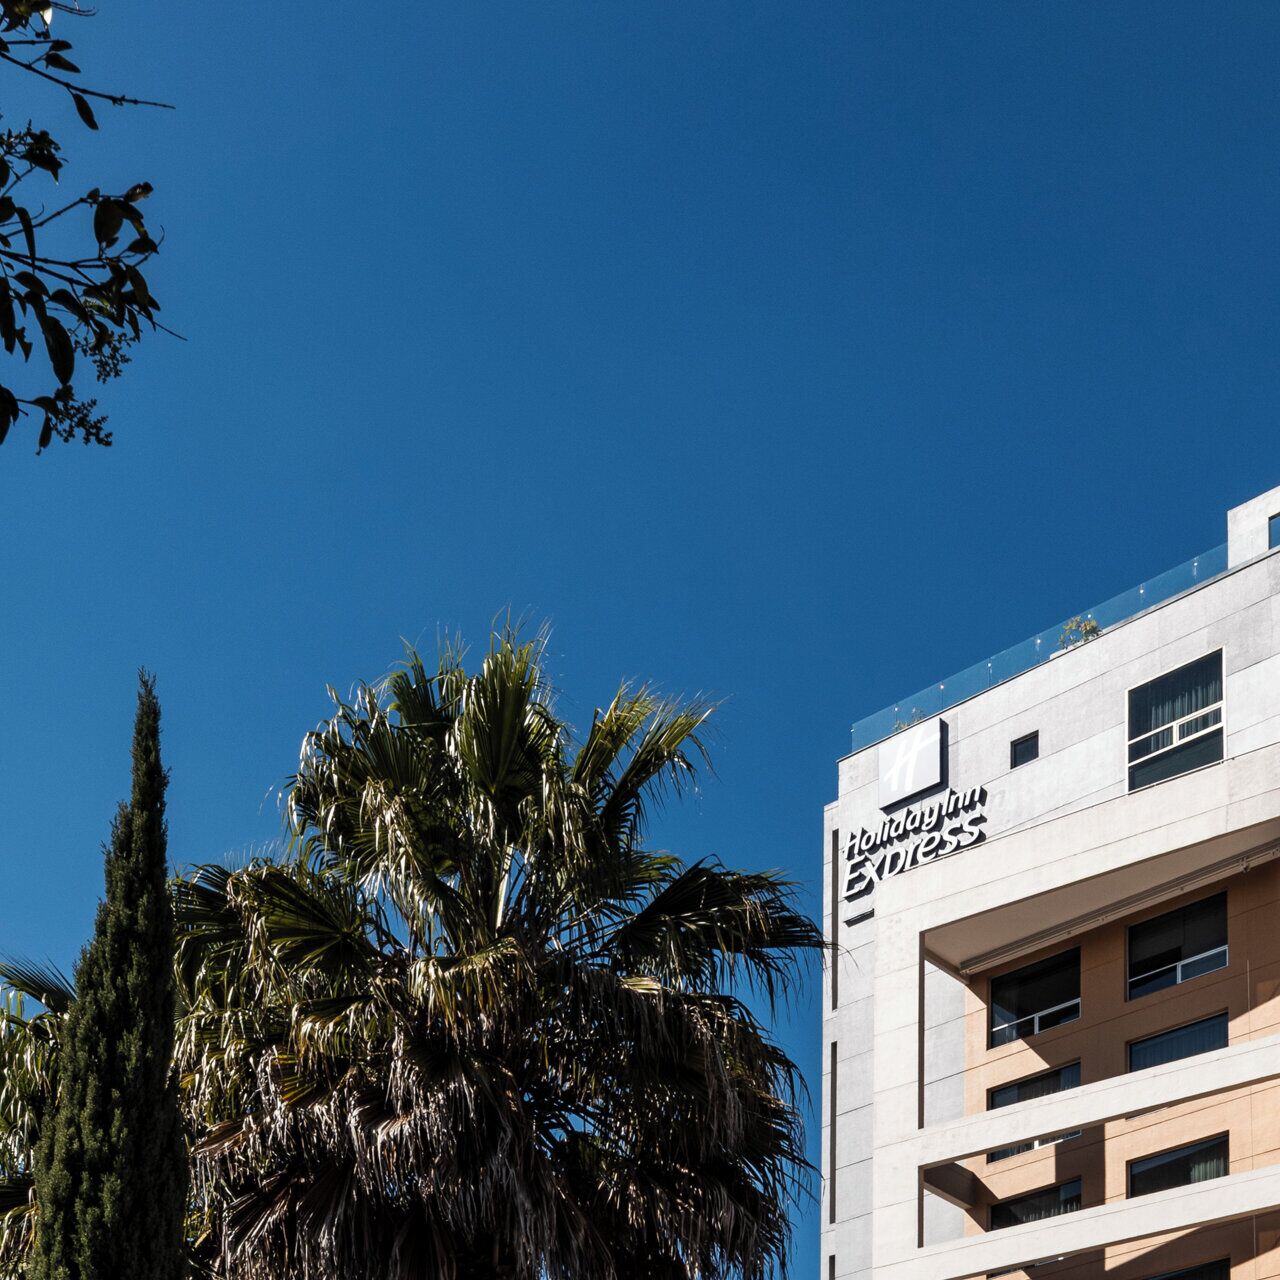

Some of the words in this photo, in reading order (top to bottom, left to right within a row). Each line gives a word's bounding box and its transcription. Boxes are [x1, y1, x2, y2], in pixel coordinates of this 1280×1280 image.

[842, 813, 988, 898] Express
[844, 803, 941, 860] Holiday
[941, 785, 982, 815] Inn
